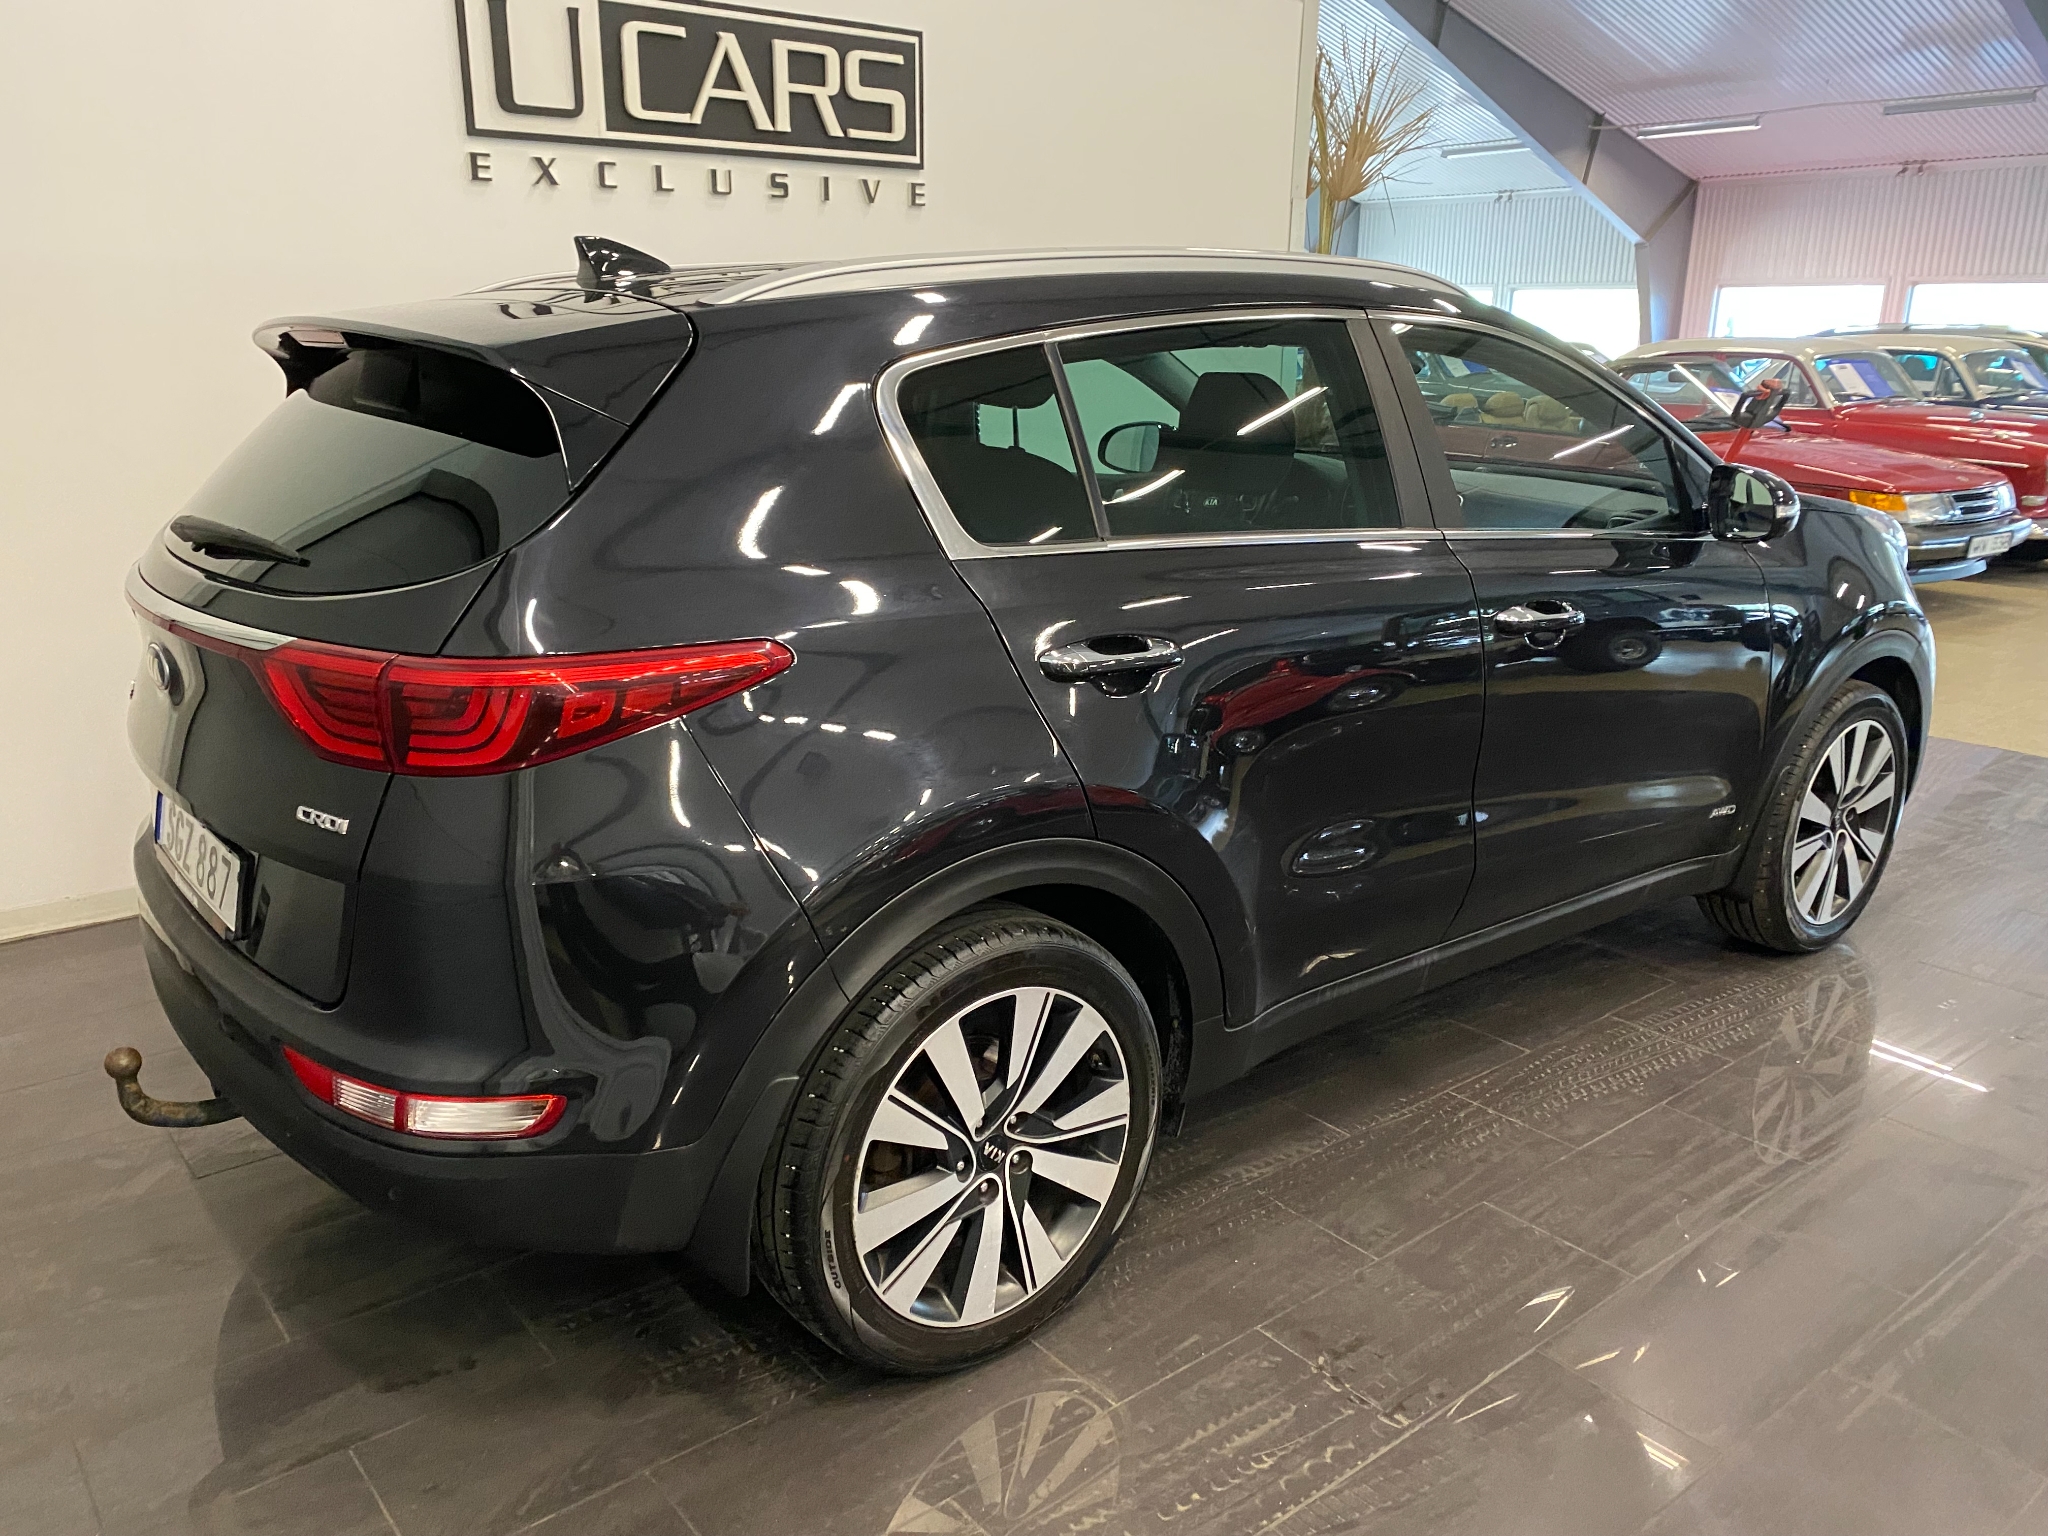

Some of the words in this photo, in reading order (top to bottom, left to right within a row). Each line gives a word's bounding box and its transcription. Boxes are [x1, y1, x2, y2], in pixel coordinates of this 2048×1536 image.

[620, 20, 906, 142] CARS
[468, 152, 926, 207] EXCLUSIVE
[196, 833, 232, 910] 887
[983, 1141, 1005, 1164] KIA
[824, 1229, 842, 1289] OUTSIDE
